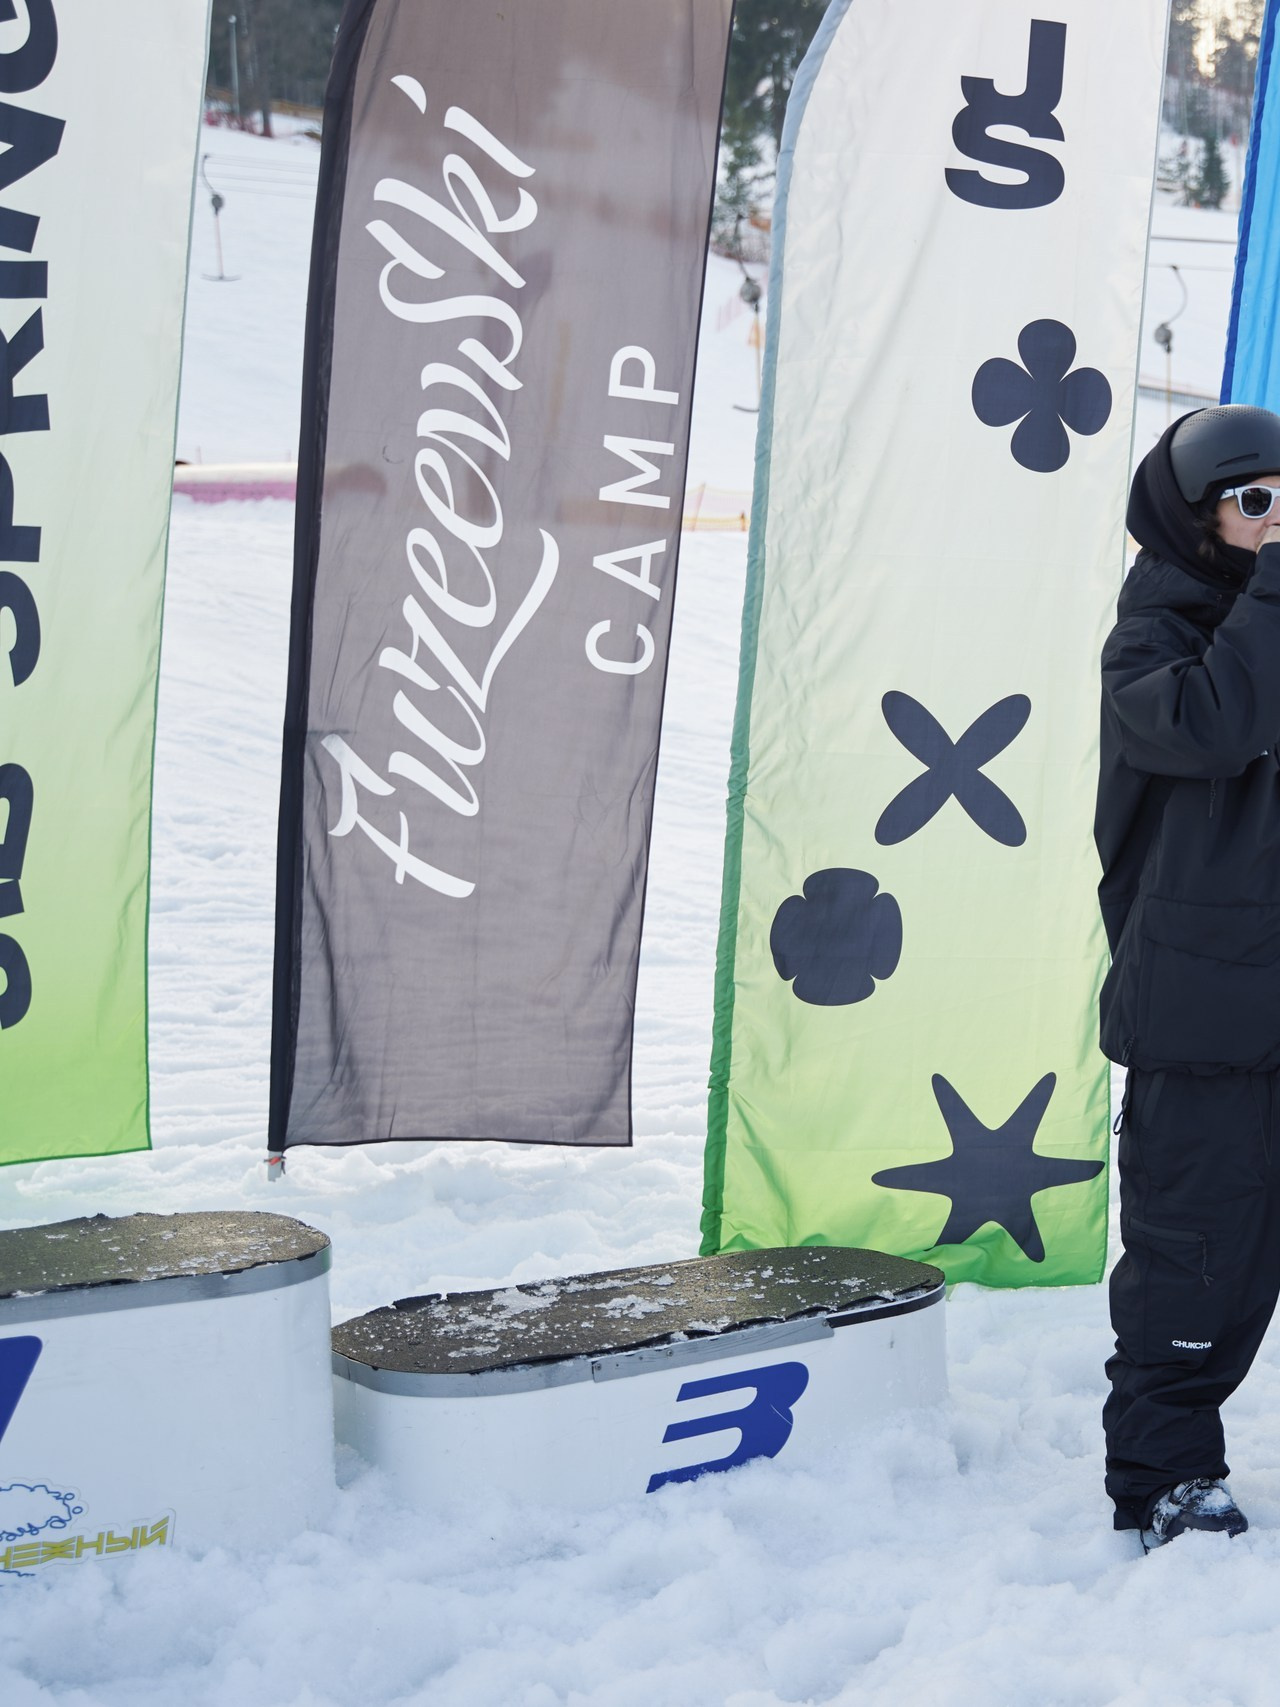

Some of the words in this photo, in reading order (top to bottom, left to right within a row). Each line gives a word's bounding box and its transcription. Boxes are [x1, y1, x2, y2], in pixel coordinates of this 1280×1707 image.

[585, 344, 680, 675] CAMP
[1171, 1340, 1212, 1350] CHUKCHA
[646, 1361, 809, 1494] 3
